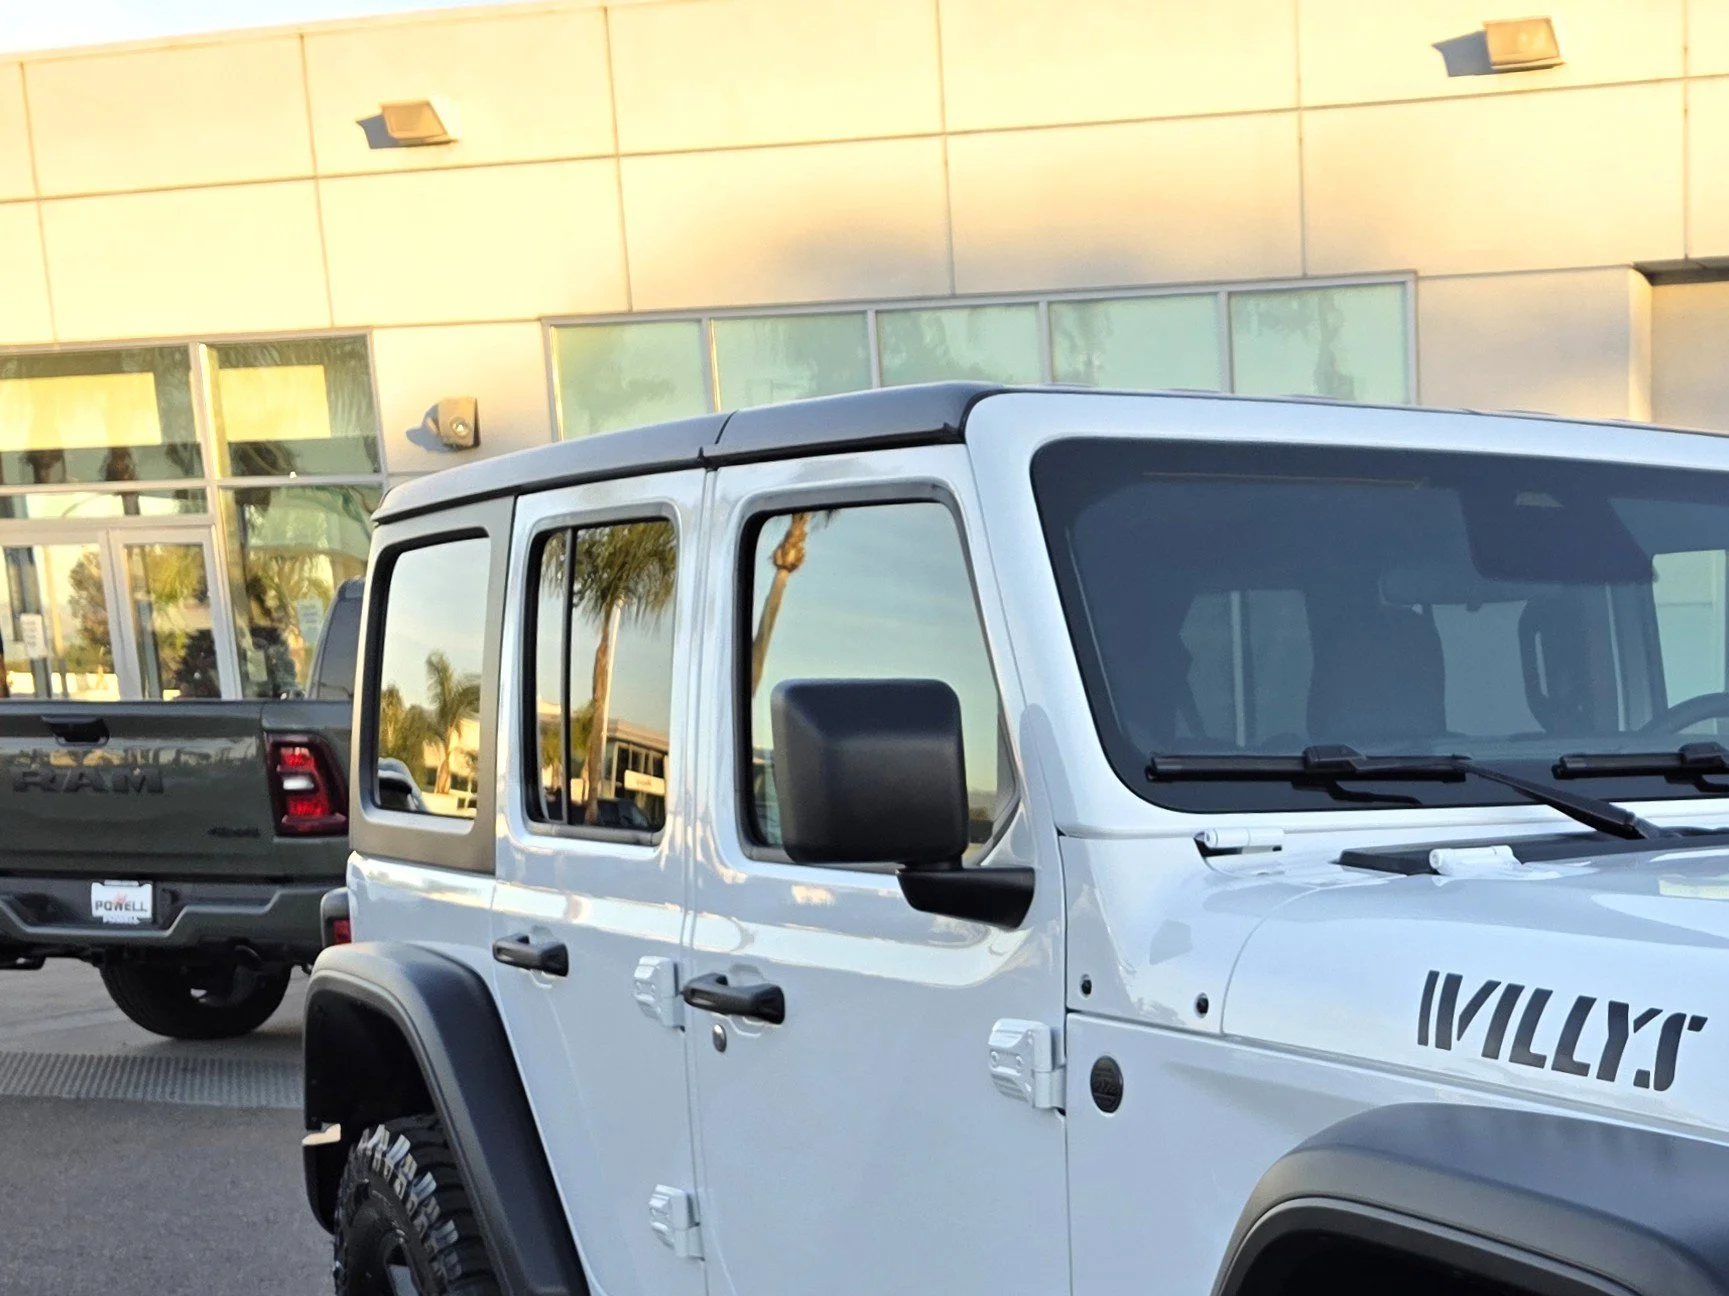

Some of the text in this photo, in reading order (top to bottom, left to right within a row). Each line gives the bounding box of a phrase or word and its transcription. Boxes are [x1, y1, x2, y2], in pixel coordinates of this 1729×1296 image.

[13, 765, 164, 793] RAM
[95, 901, 147, 912] POWELL
[1417, 970, 1709, 1092] WILLYS
